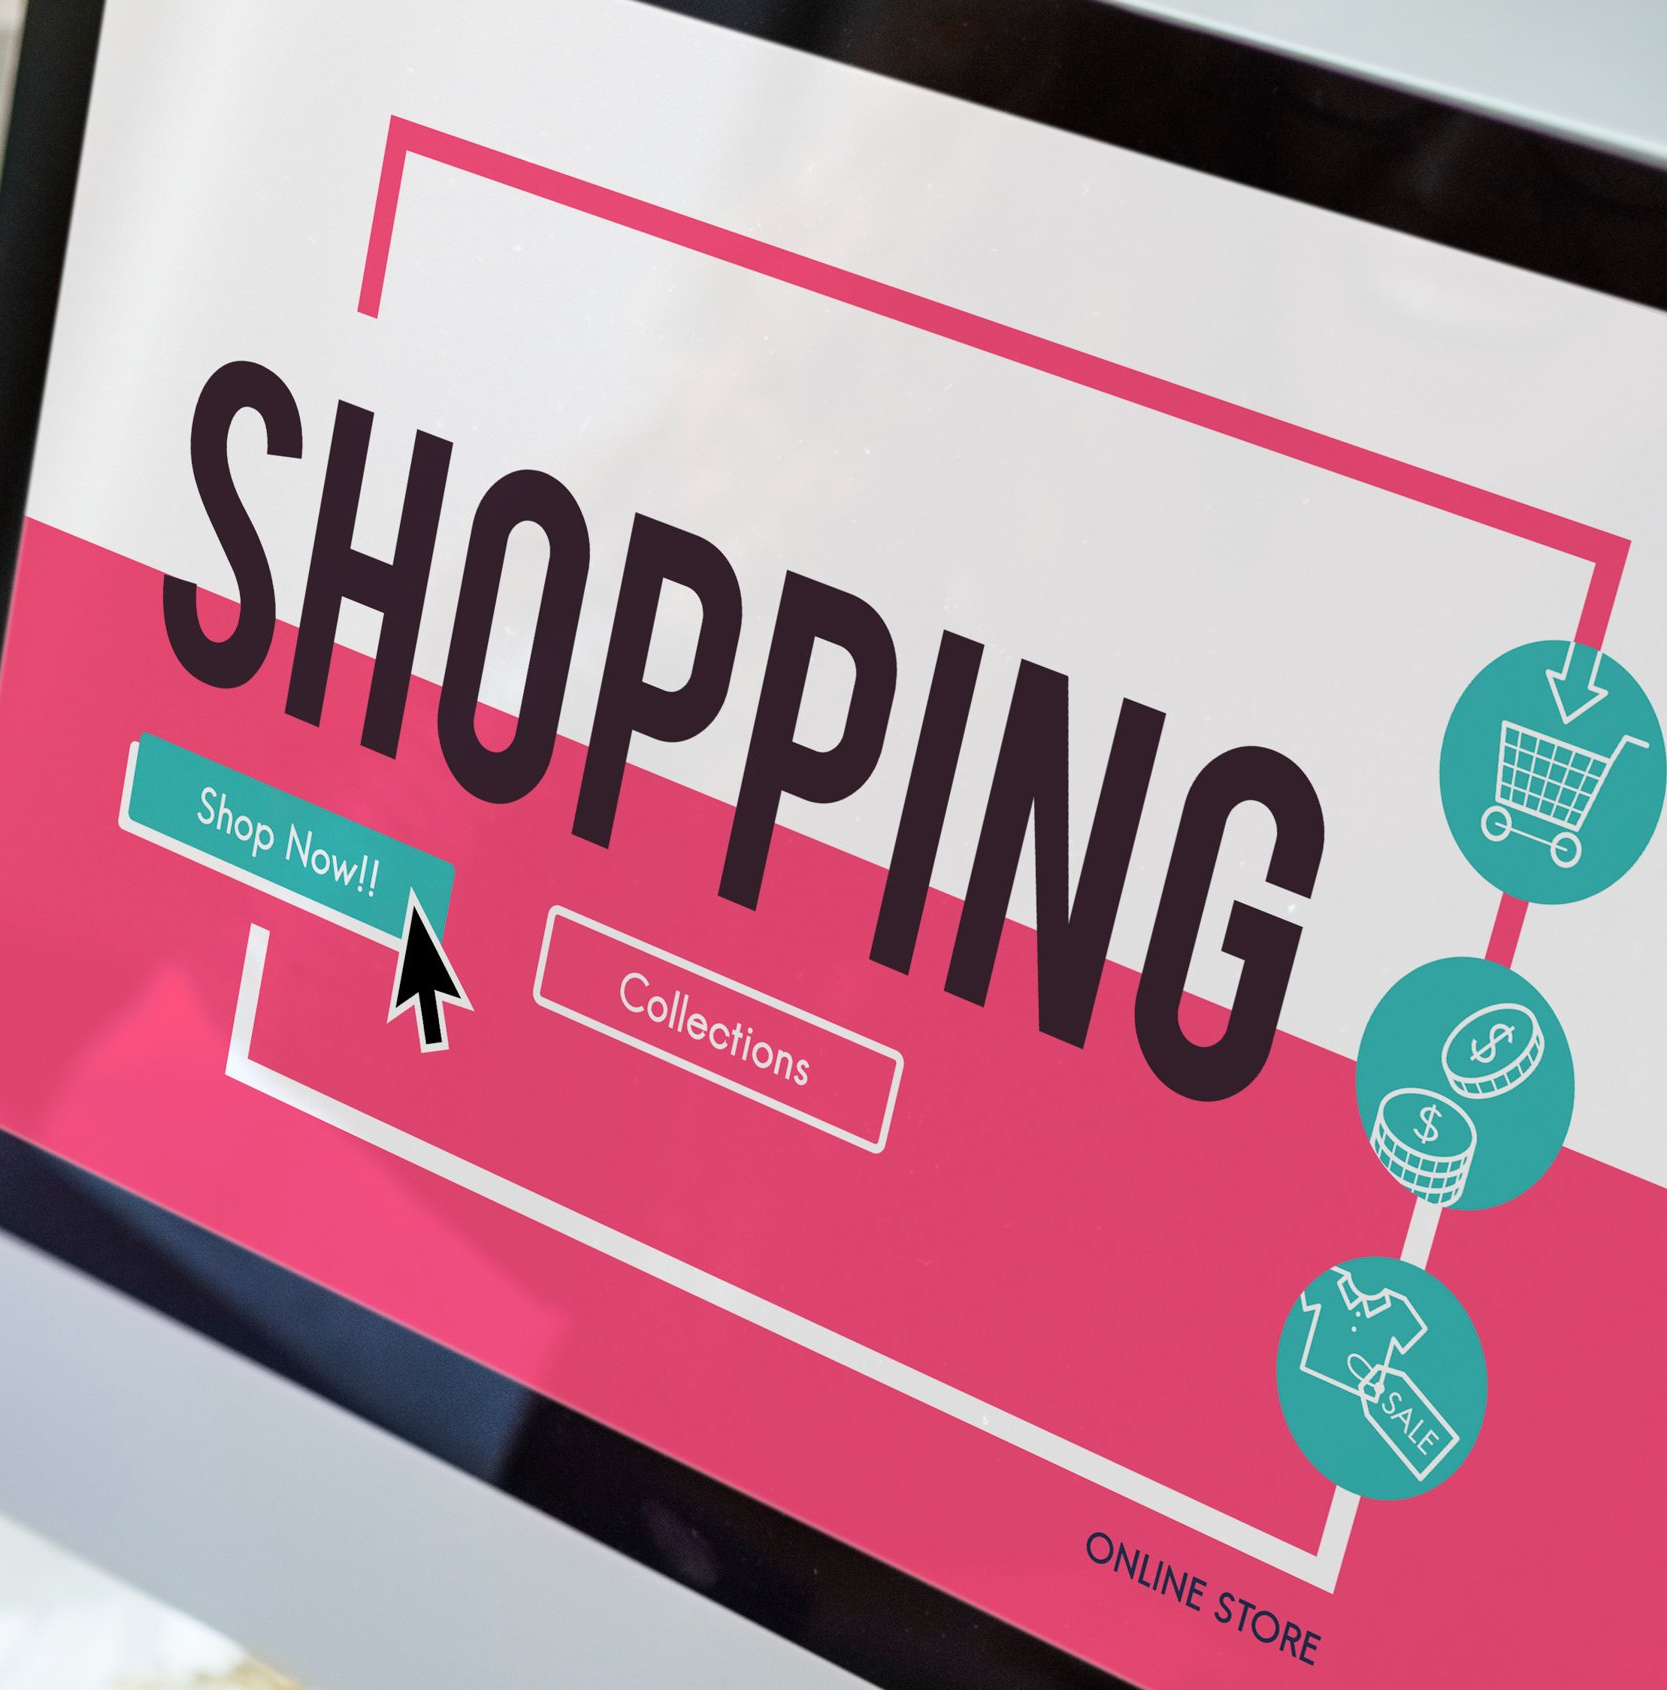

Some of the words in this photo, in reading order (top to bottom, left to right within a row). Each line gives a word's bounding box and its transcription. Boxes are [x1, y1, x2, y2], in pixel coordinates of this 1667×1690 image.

[163, 360, 1325, 1102] SHOPPING
[196, 786, 275, 858] Shop
[285, 823, 380, 889] Now!!
[619, 972, 810, 1086] Collections
[1381, 1391, 1440, 1456] SALE
[1086, 1531, 1208, 1612] ONLINE
[1214, 1591, 1322, 1666] STORE
